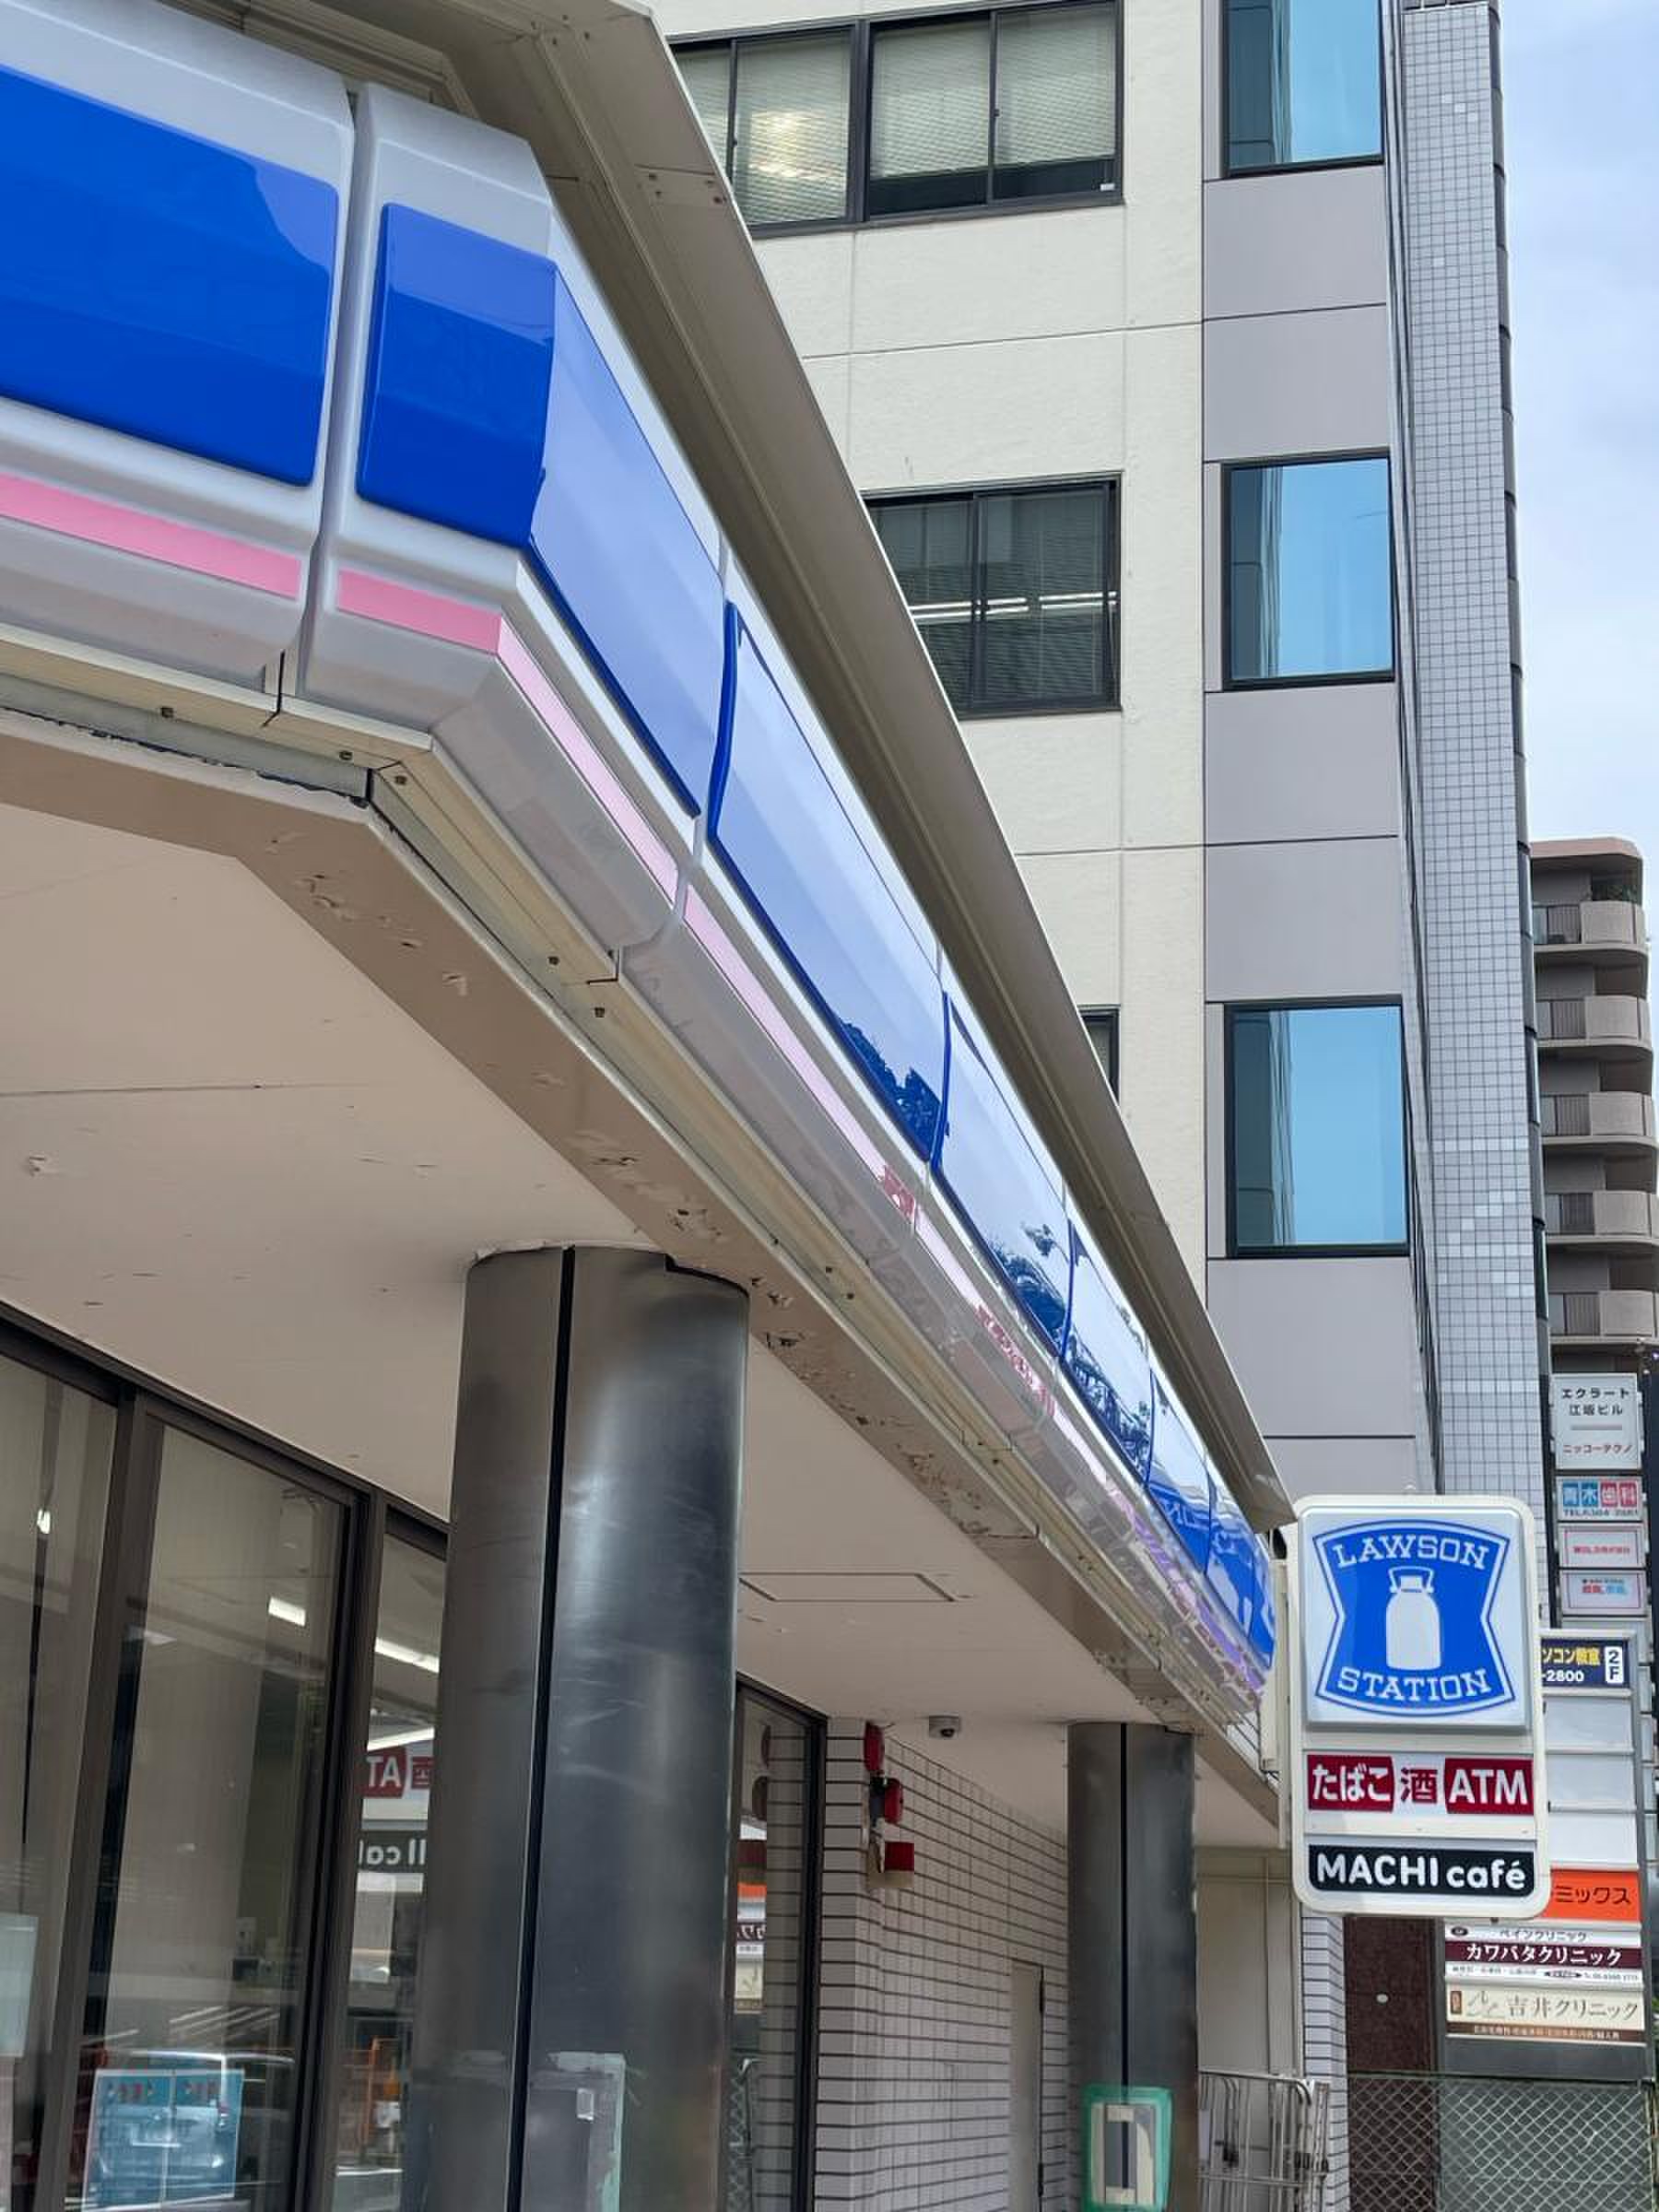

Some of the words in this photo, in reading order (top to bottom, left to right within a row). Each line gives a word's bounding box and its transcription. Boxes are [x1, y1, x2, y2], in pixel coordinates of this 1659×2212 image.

[1561, 1387, 1630, 1399] エクラート
[1332, 1534, 1490, 1570] LAWSON
[1337, 1666, 1491, 1702] STATION
[1312, 1763, 1392, 1803] たばこ
[1399, 1767, 1438, 1804] 酒
[1448, 1769, 1528, 1806] ATM
[1316, 1853, 1439, 1887] MACHI
[1446, 1857, 1526, 1890] café
[1555, 1885, 1630, 1905] ミックス
